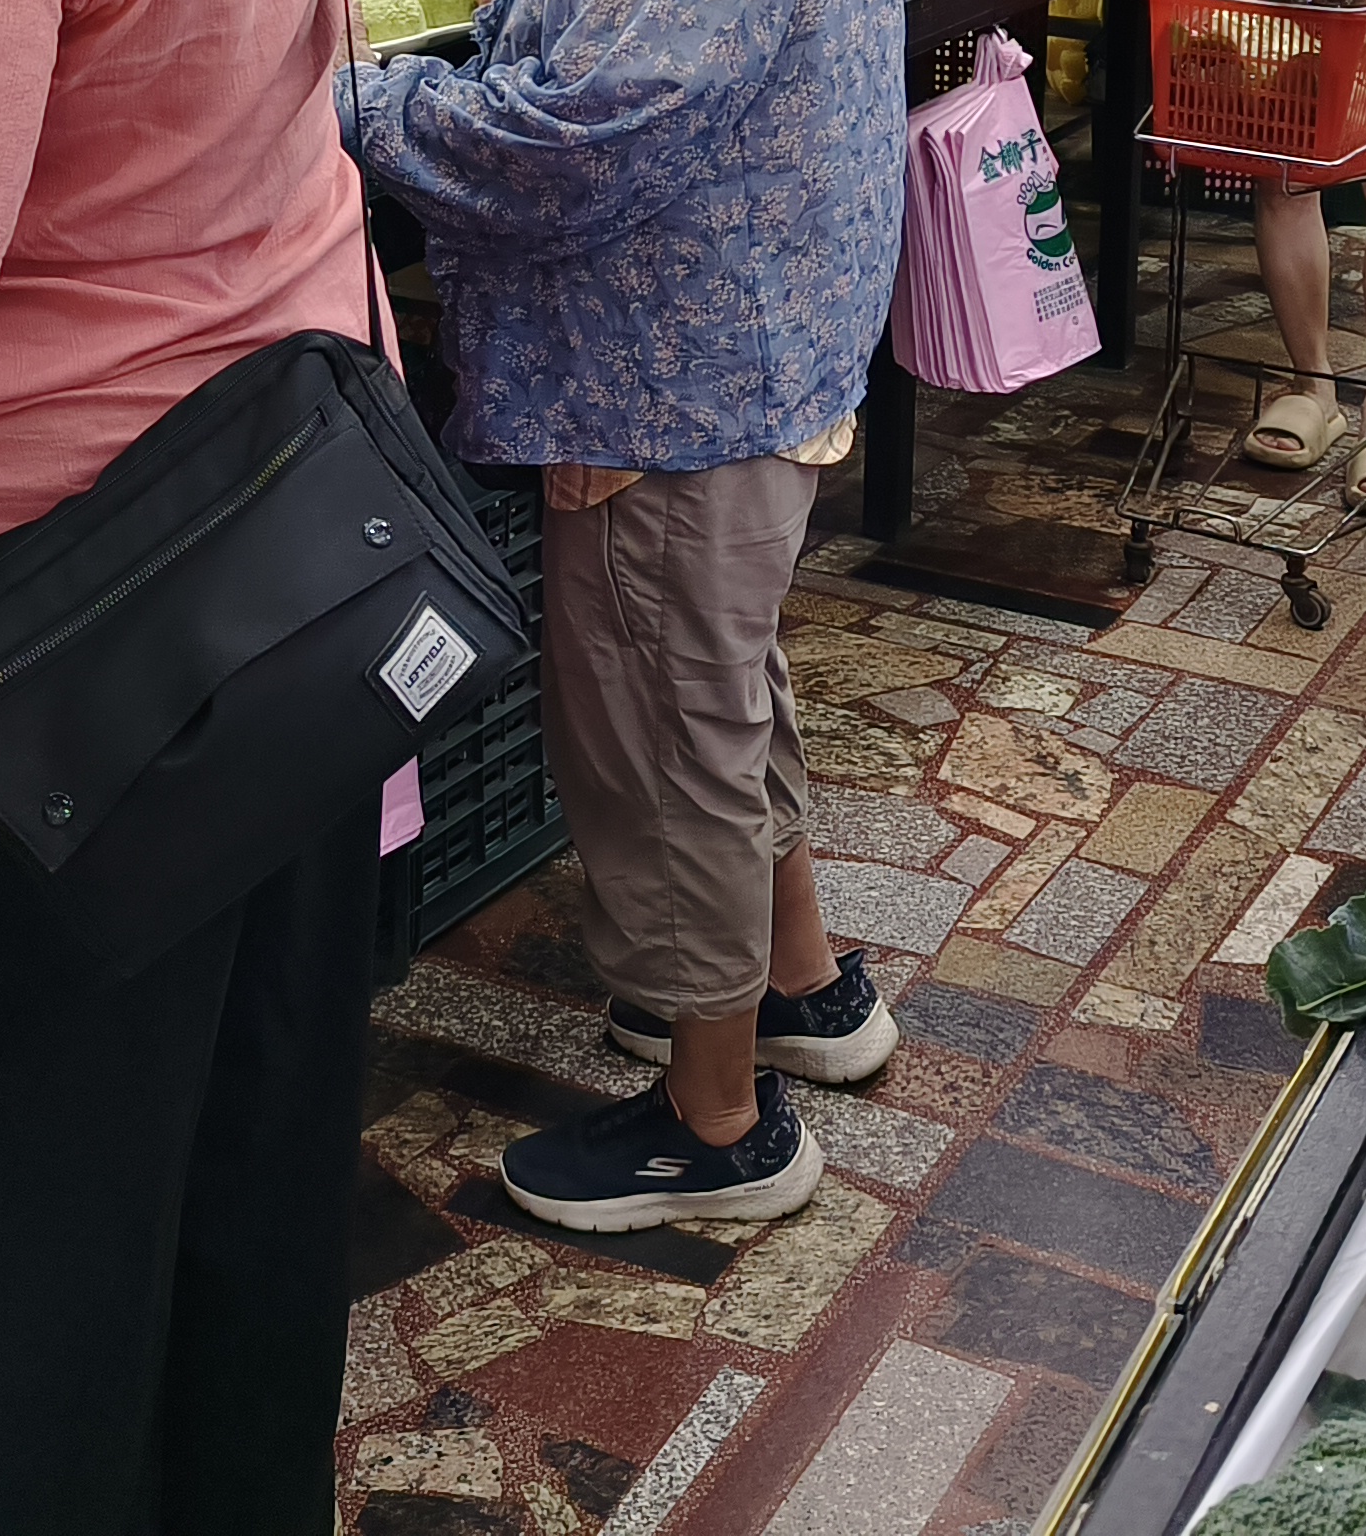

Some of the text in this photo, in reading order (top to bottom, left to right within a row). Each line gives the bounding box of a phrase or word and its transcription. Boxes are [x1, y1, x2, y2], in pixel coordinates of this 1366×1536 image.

[978, 128, 1042, 184] 金椰子
[1026, 247, 1061, 272] Golden
